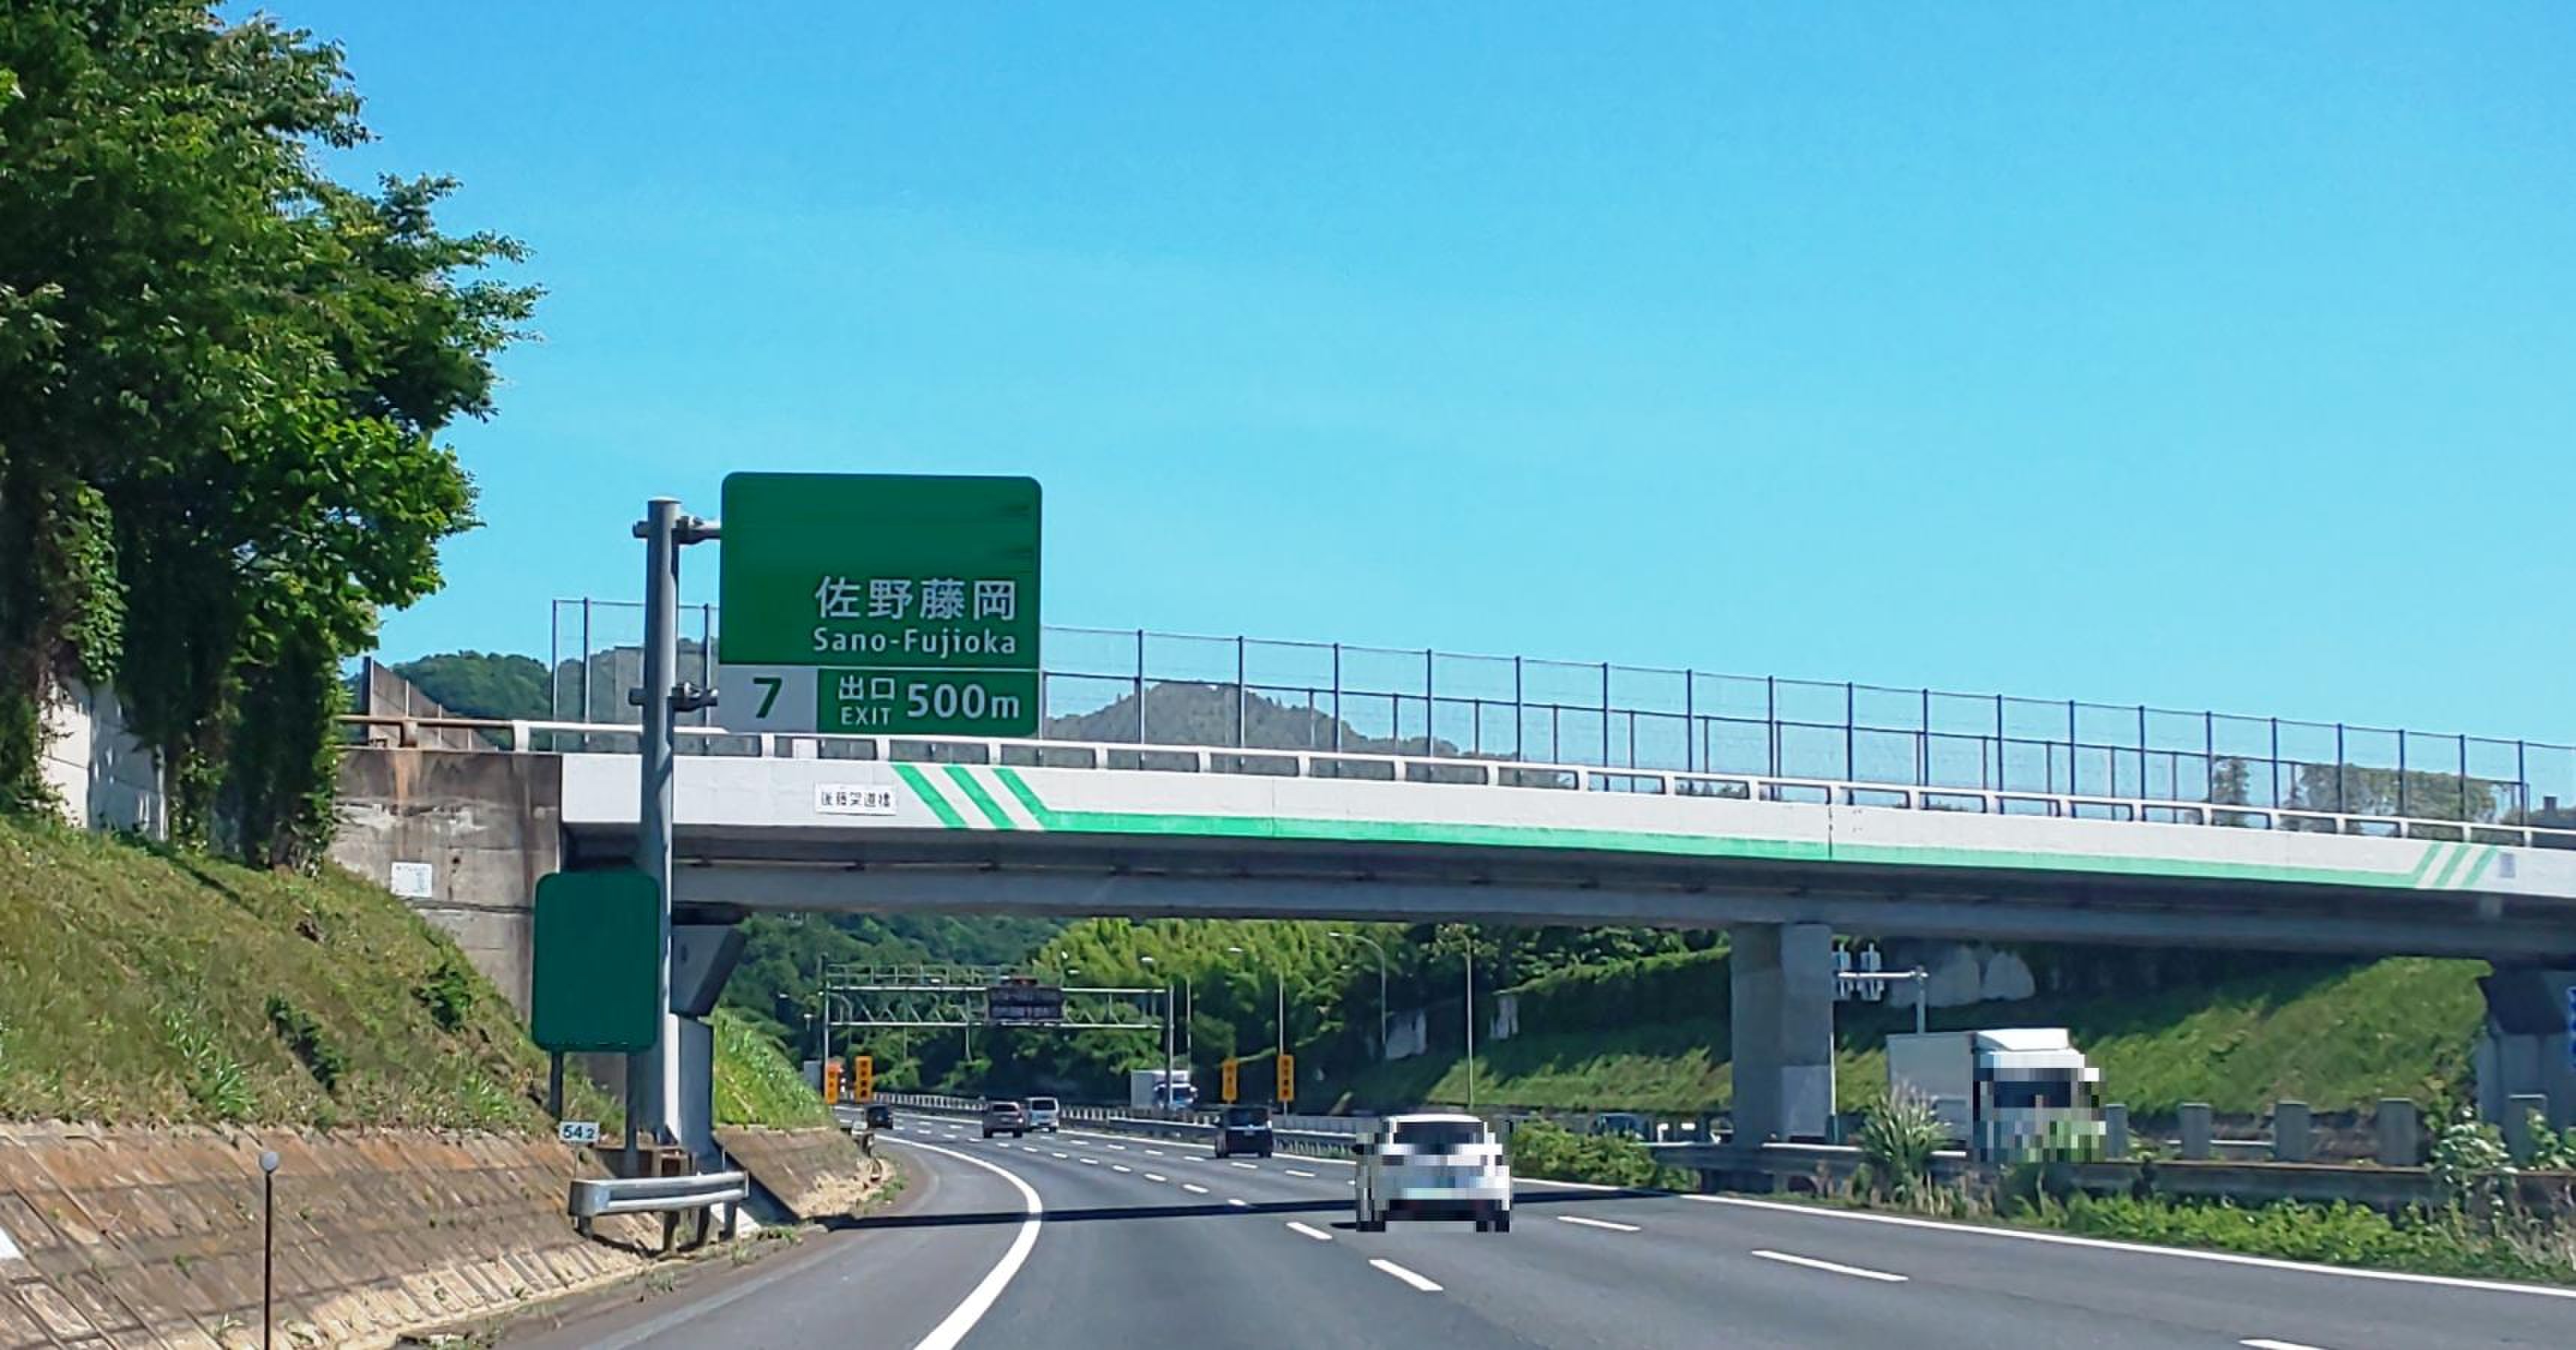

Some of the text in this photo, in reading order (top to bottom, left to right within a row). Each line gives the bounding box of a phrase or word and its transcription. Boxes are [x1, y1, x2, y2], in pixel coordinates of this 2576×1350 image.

[815, 575, 1016, 621] 佐野藤岡
[813, 627, 1016, 658] Sano-Fujioka
[752, 676, 782, 718] 7
[838, 675, 896, 701] 出口
[906, 683, 1019, 718] 500m
[840, 706, 892, 725] EXIT
